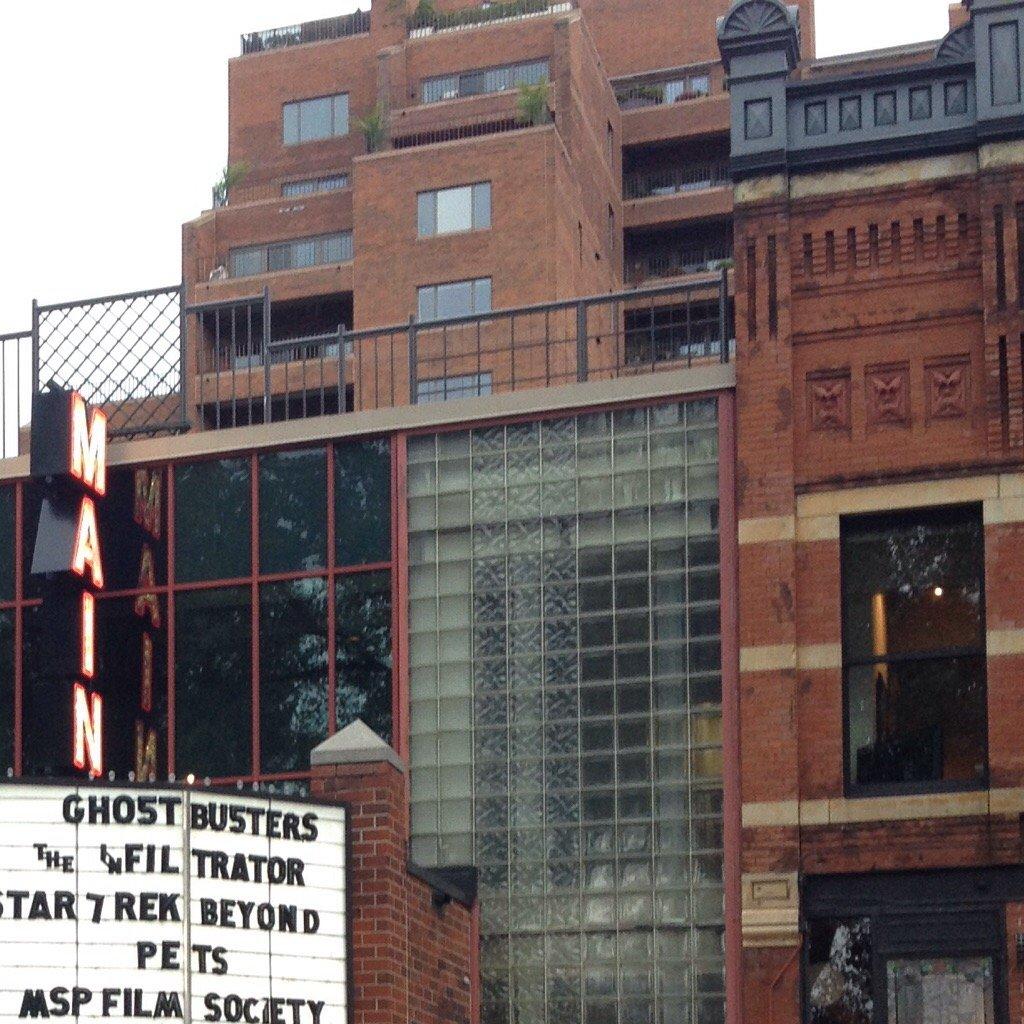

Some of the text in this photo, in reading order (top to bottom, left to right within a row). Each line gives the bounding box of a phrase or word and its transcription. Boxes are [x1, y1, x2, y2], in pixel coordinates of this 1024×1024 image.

[70, 391, 107, 777] MAIN
[190, 802, 319, 842] BUSTERS
[33, 843, 74, 873] THE
[200, 898, 320, 935] BEYOND
[18, 987, 92, 1018] MSP
[102, 988, 183, 1019] FILM
